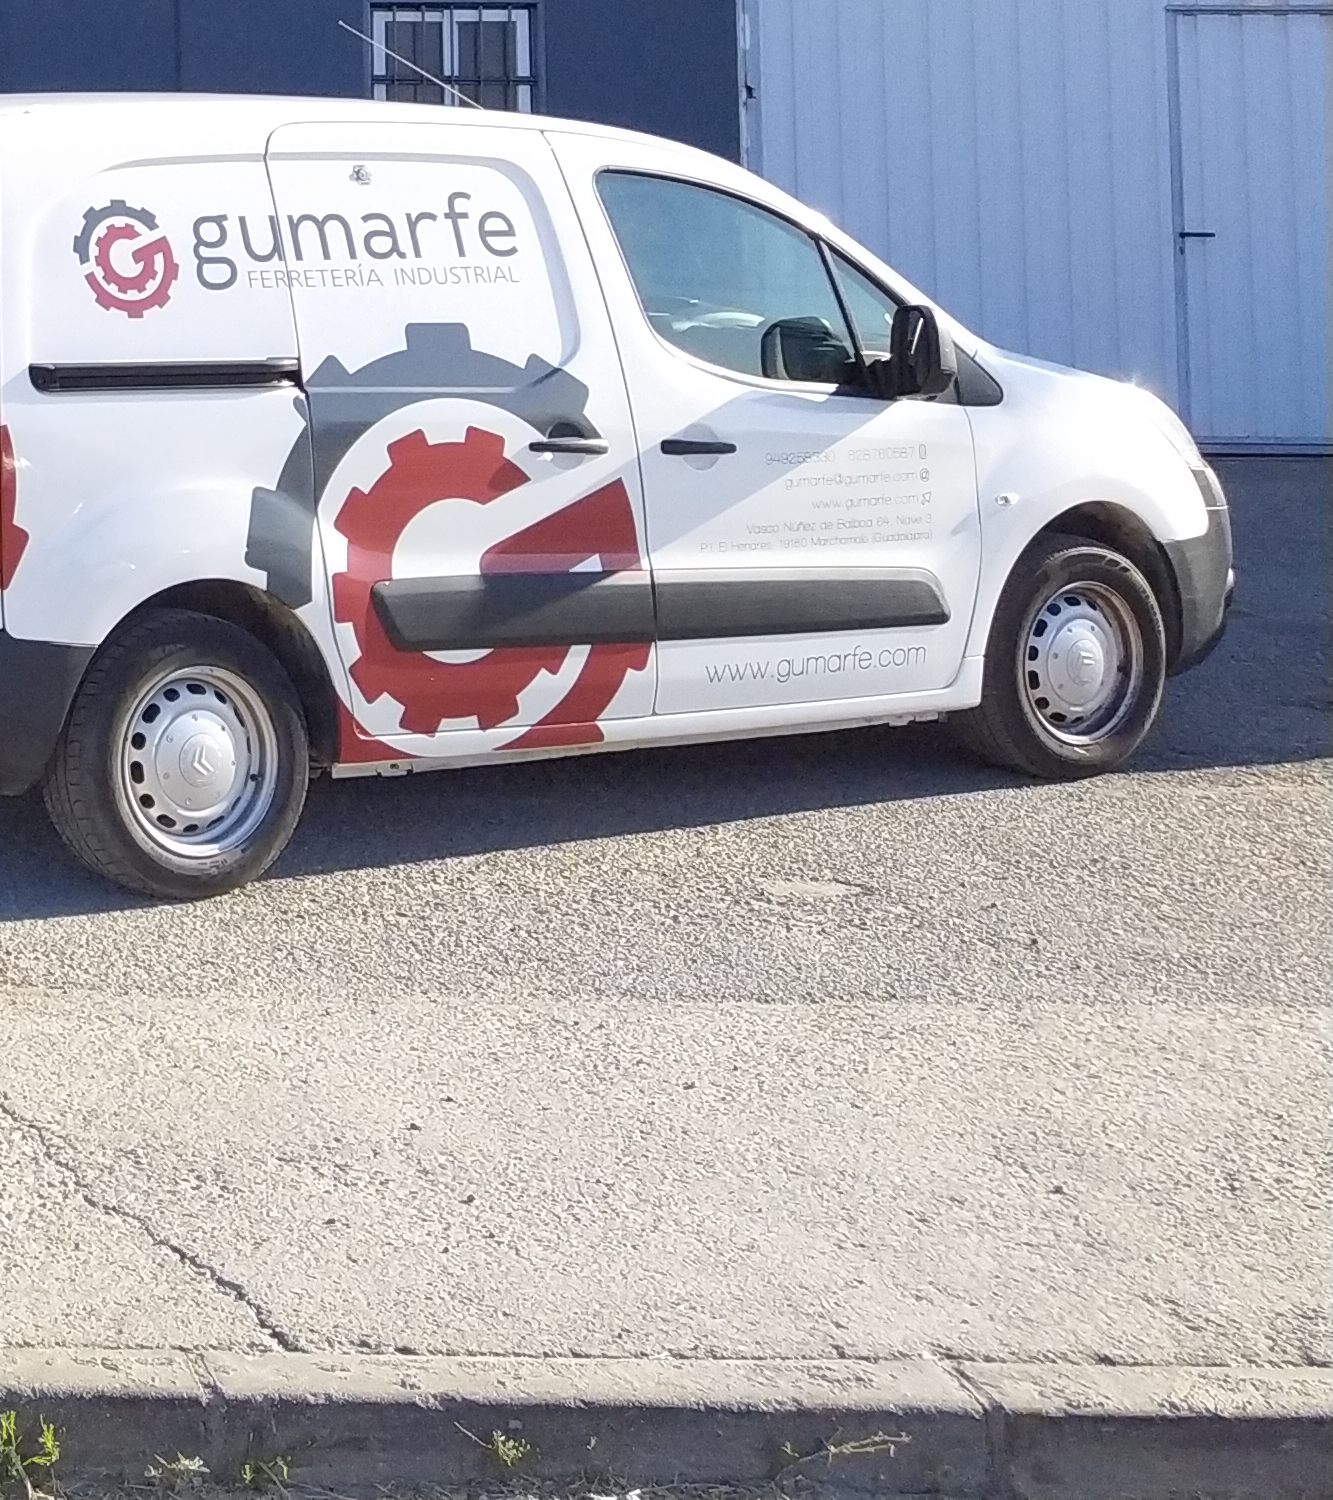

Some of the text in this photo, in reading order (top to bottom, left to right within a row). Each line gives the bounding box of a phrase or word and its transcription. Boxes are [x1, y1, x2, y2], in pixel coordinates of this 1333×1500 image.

[192, 191, 519, 290] gumarfe
[247, 263, 520, 289] FERRETERÍA INDUSTRIAL
[705, 645, 927, 684] www.gumarfe.com
